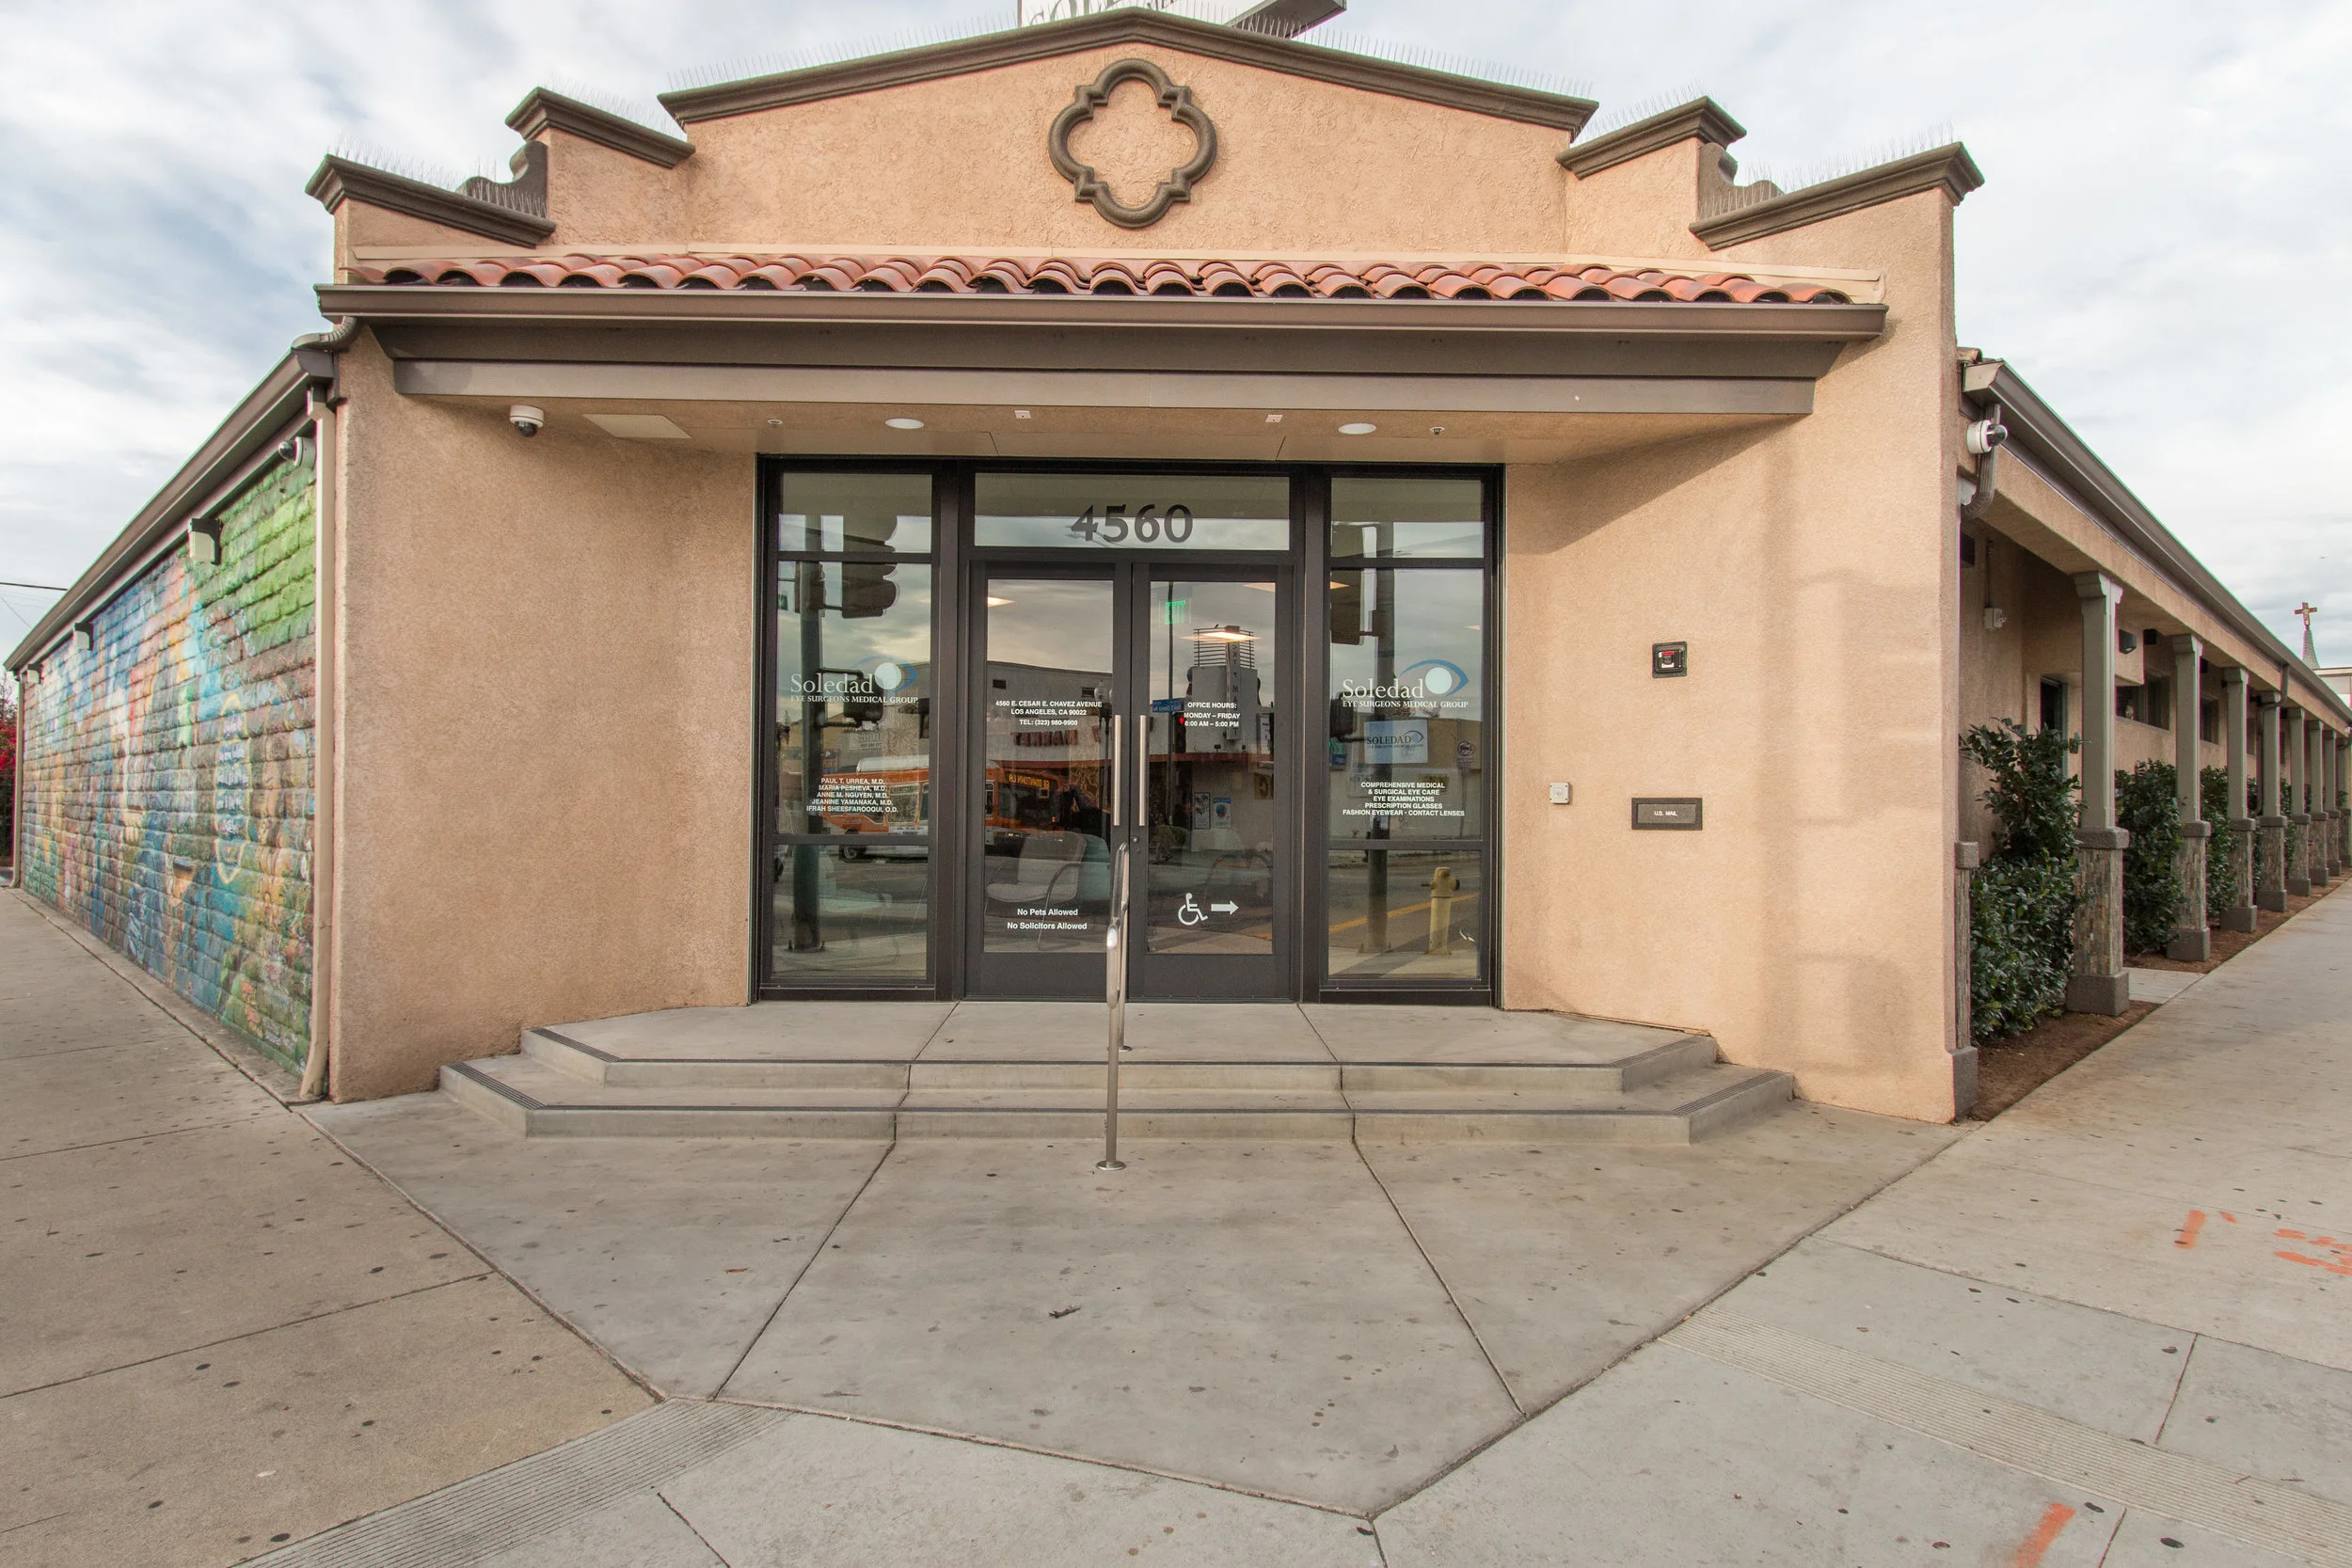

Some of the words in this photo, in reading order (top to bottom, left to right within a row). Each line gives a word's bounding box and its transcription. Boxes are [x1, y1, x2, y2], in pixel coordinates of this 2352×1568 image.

[1071, 504, 1193, 543] 4560
[791, 673, 874, 693] Soledad
[1343, 678, 1425, 698] Soledad
[1367, 736, 1411, 744] SOLEDAD
